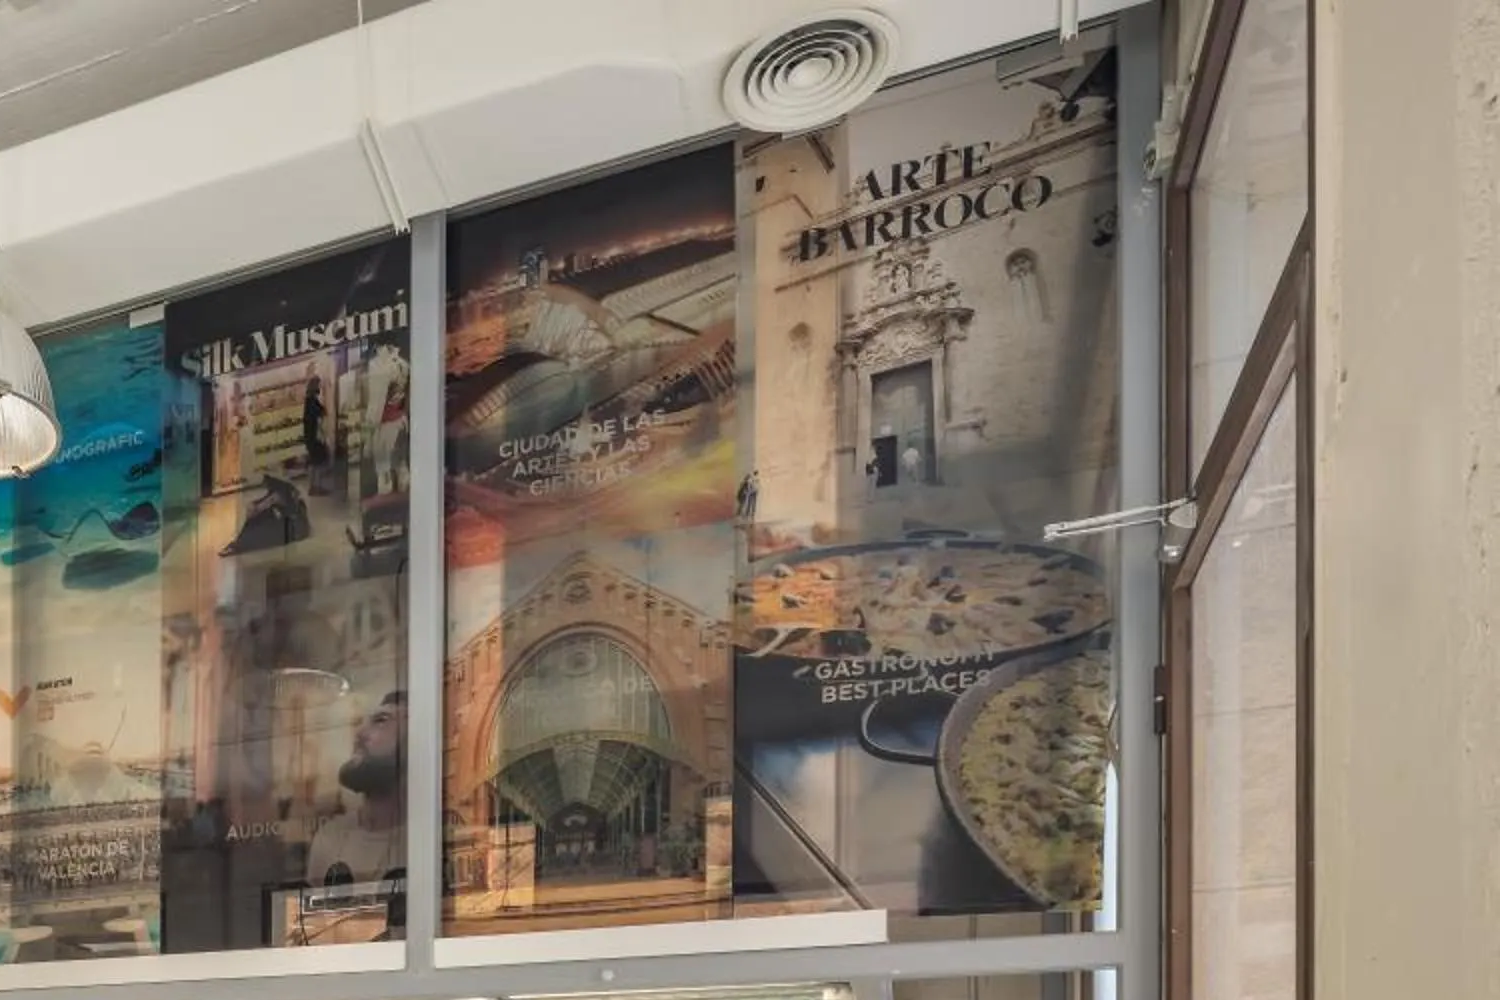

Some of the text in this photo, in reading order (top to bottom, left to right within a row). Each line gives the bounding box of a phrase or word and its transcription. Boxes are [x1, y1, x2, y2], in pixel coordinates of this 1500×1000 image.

[857, 140, 992, 202] ARTE
[794, 175, 1053, 262] BARROCO
[181, 301, 409, 378] Silk Museum
[821, 668, 992, 703] BEST PLACES
